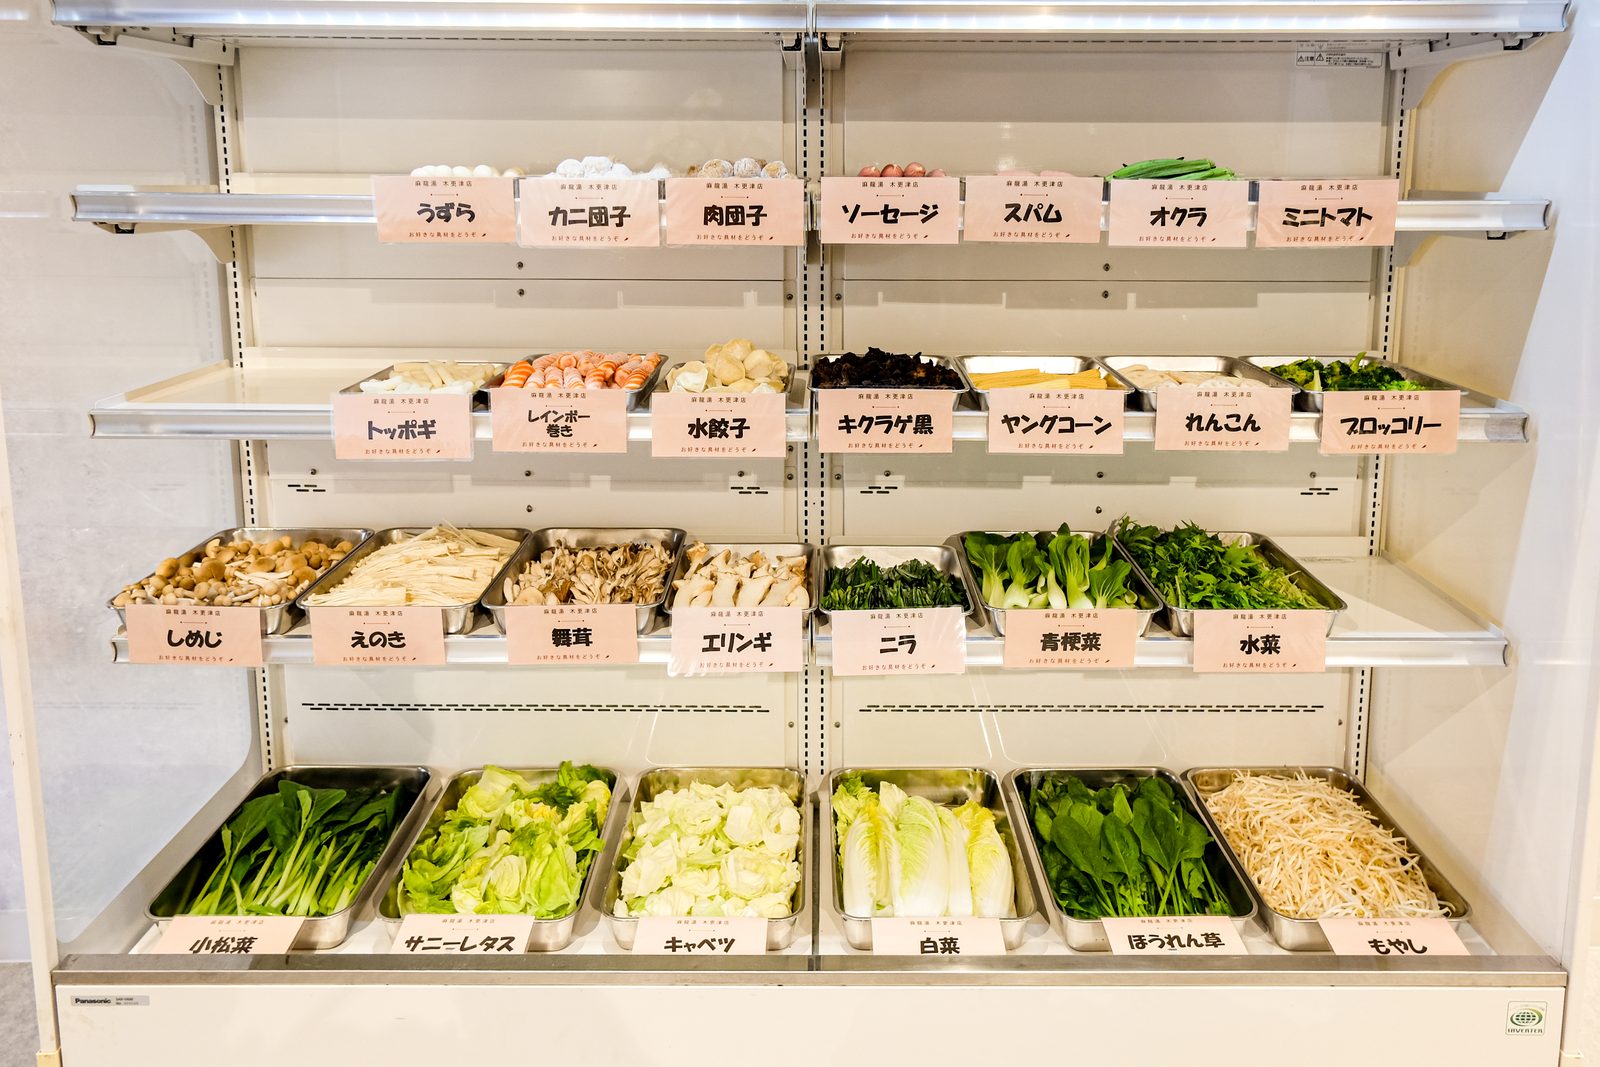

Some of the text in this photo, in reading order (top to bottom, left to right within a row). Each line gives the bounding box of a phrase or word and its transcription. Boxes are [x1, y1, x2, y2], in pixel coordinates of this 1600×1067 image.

[442, 179, 472, 188] 木更津店
[588, 183, 617, 191] 木更津店
[734, 182, 763, 190] 木更津店
[890, 180, 918, 189] 木更津店
[1034, 180, 1063, 188] 木更津店
[1179, 183, 1207, 192] 木更津店
[1328, 183, 1358, 192] 木更津店
[417, 202, 475, 223] うずら
[549, 206, 631, 227] カニ団子
[703, 204, 767, 226] 肉団子
[842, 204, 938, 224] ソーセージ
[1004, 203, 1062, 223] スパム
[1150, 206, 1207, 227] オクラ
[1282, 207, 1373, 227] ミニトマト
[401, 397, 429, 405] 木更津店
[557, 391, 586, 400] 木更津店
[717, 396, 746, 404] 木更津店
[883, 392, 913, 401] 木更津店
[1056, 392, 1084, 400] 木更津店
[1223, 390, 1252, 399] 木更津店
[1391, 394, 1419, 402] 木更津店
[528, 410, 590, 424] レインボー
[838, 414, 934, 435] キクラゲ黒
[1001, 414, 1112, 435] ヤングコーン
[1185, 413, 1261, 432] れんこん
[368, 420, 436, 440] トッポギ
[546, 424, 573, 438] 巻き
[688, 418, 750, 439] 水餃子
[1340, 416, 1441, 436] ブロッコリー
[192, 608, 220, 617] 木更津店
[570, 607, 597, 615] 木更津店
[896, 612, 923, 620] 木更津店
[1071, 612, 1098, 620] 木更津店
[1259, 613, 1287, 621] 木更津店
[167, 629, 222, 648] しめじ
[351, 631, 406, 648] えのき
[552, 627, 593, 647] 舞茸
[702, 632, 772, 653] エリンギ
[880, 635, 916, 654] ニラ
[1040, 632, 1101, 651] 青梗菜
[1240, 634, 1281, 655] 水菜
[189, 936, 258, 954] 小松菜
[404, 936, 516, 952] サニーレタス
[664, 936, 735, 953] キャベツ
[920, 937, 960, 954] 白菜
[1128, 932, 1225, 950] ほうれん草
[1368, 938, 1427, 955] もやし
